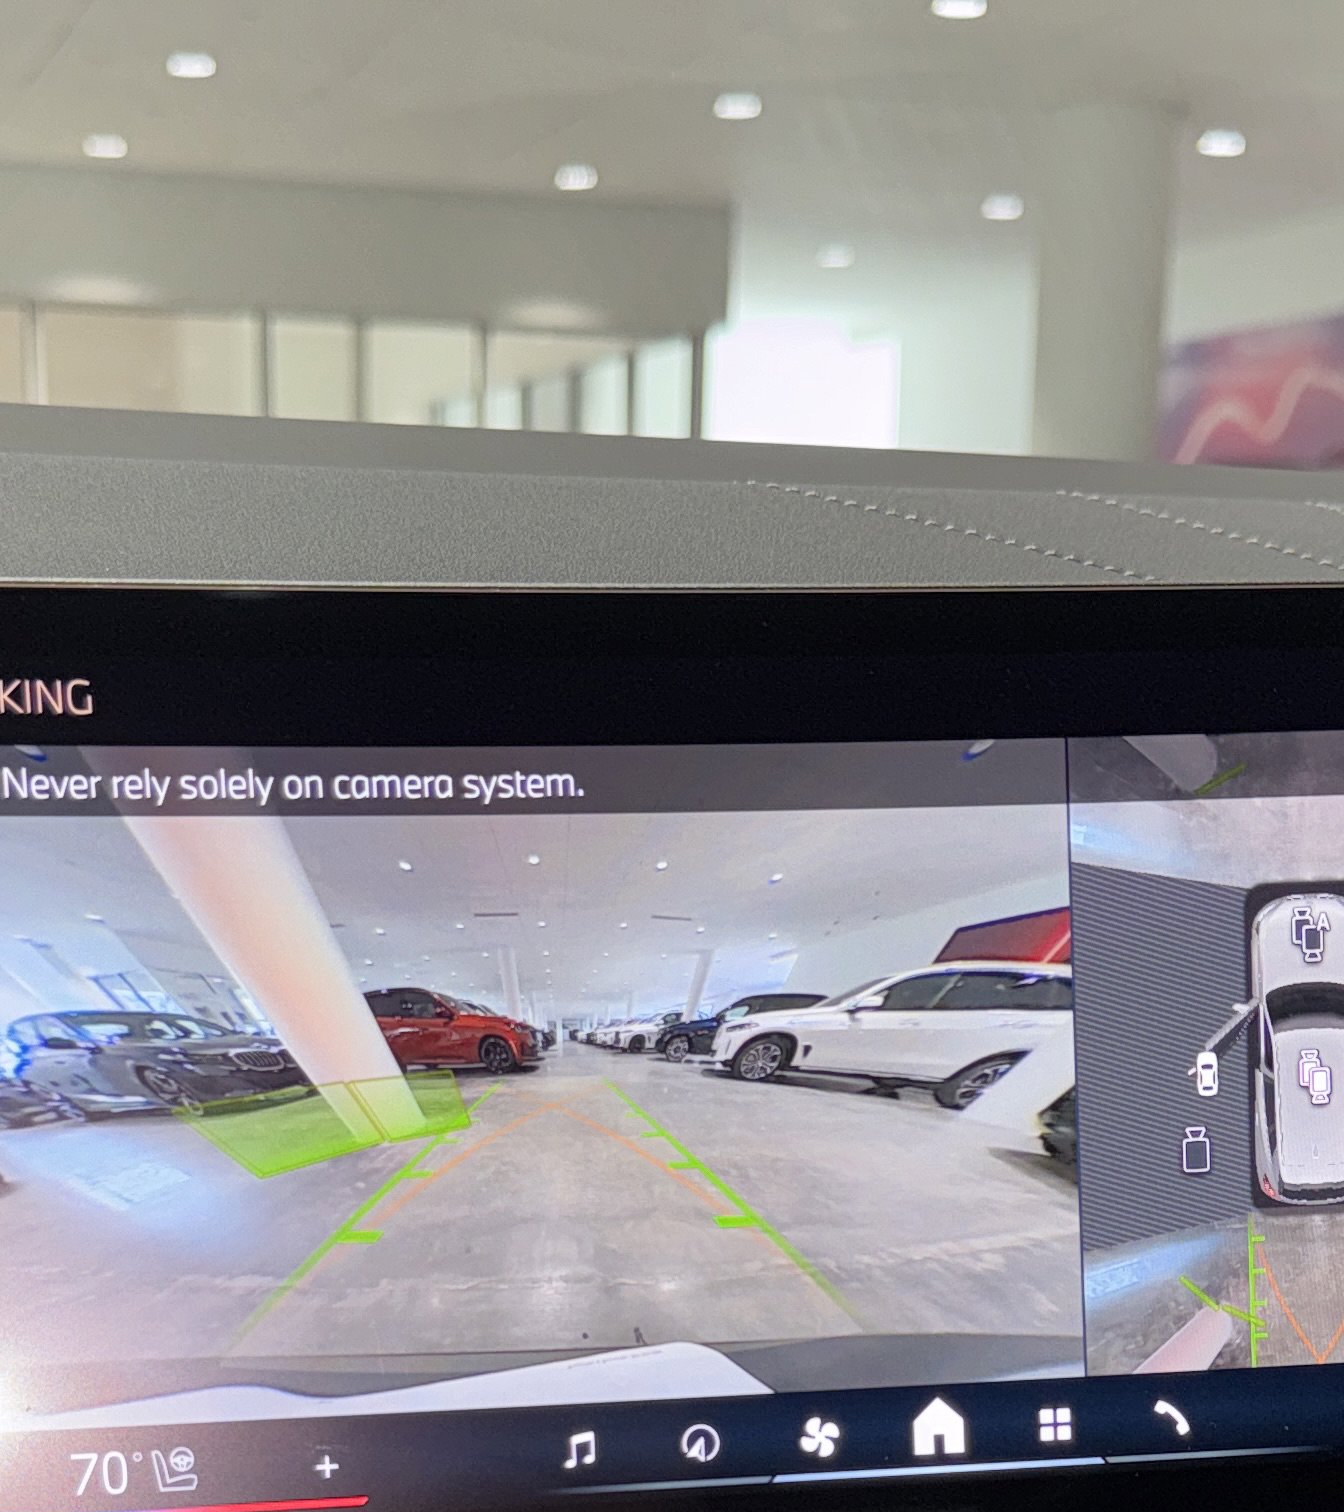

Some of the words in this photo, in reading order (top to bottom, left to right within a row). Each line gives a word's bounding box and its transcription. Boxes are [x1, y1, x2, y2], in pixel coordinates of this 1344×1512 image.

[1, 766, 102, 801] Never
[111, 767, 168, 806] rely
[179, 767, 275, 806] solely
[283, 773, 324, 800] on
[333, 773, 454, 800] camera
[464, 769, 585, 804] system.
